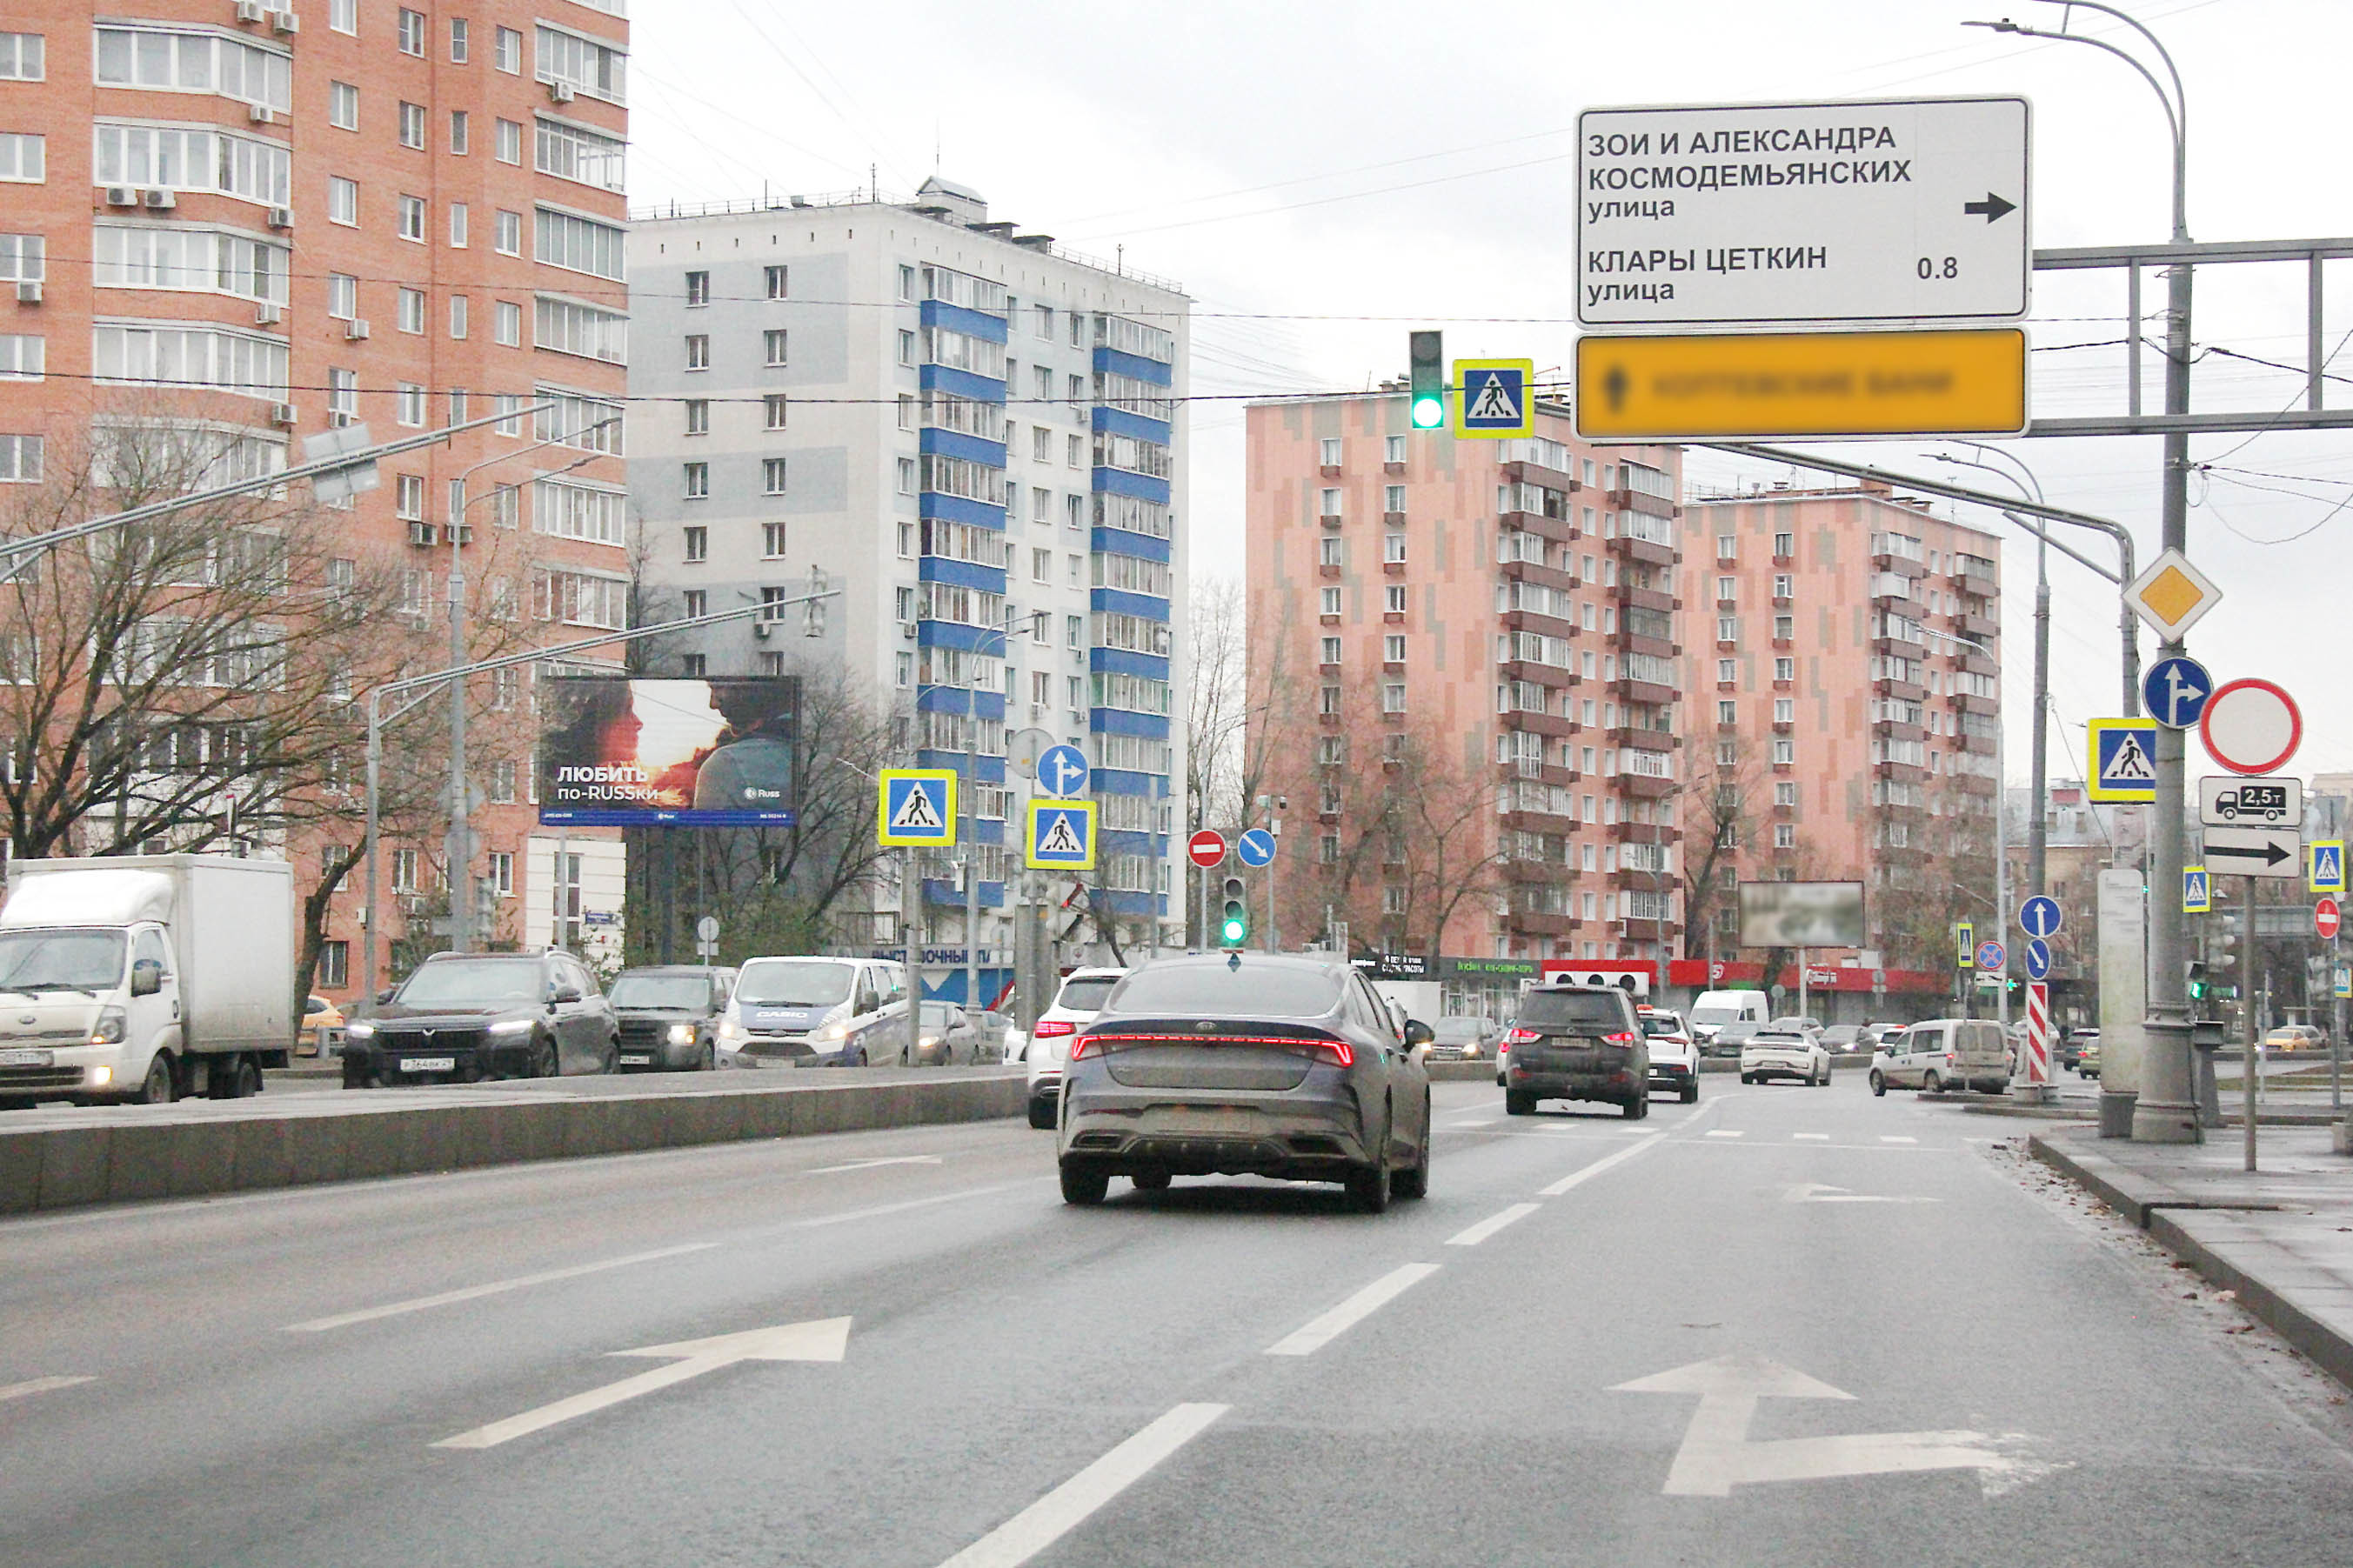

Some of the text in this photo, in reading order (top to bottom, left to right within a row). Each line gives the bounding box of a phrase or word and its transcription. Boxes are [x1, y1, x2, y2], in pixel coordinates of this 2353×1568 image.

[1588, 126, 1896, 157] ЗОИ И АЛЕКСАНДРА
[1588, 159, 1912, 192] КОСМОДЕМЬЯНСКИХ
[1588, 200, 1675, 224] улица
[1588, 246, 1827, 275] КЛАРЫ ЦЕТКИН
[1917, 257, 1958, 280] 0.8
[1588, 282, 1675, 306] улица
[557, 766, 648, 783] ЛЮБИТЬ
[558, 785, 658, 800] по-RUSSки
